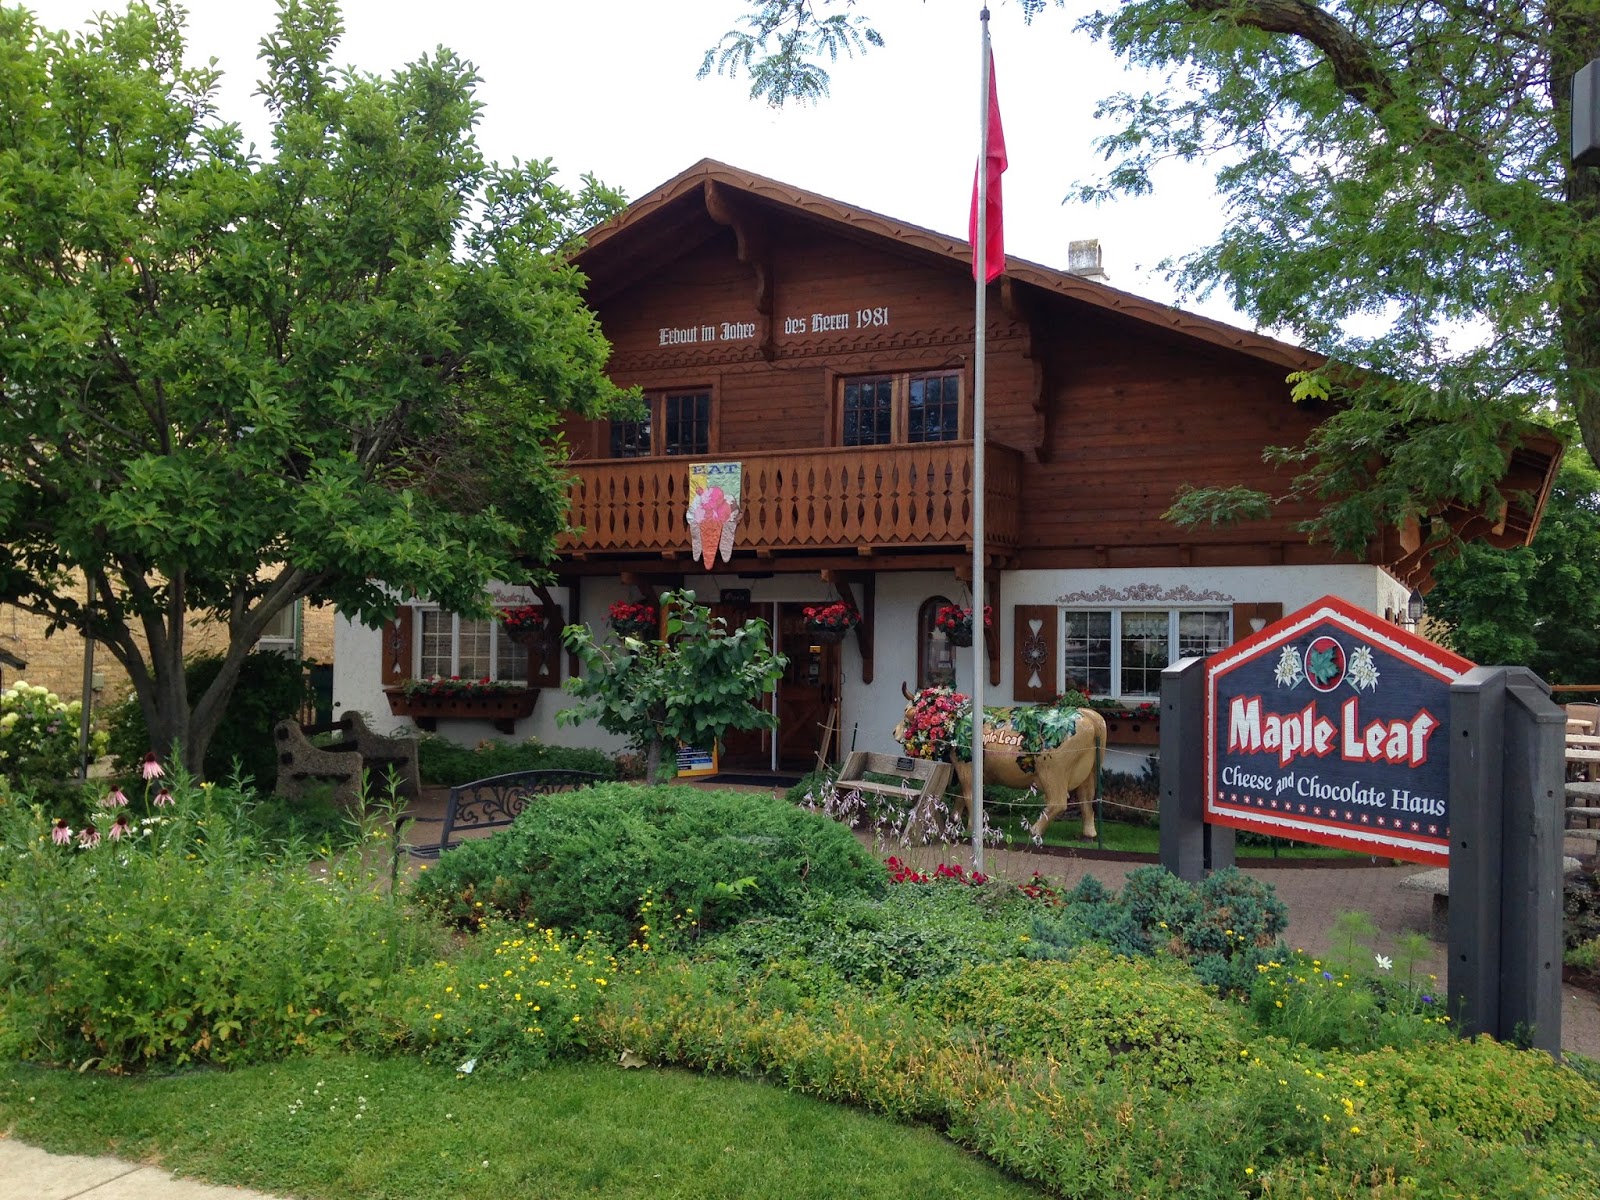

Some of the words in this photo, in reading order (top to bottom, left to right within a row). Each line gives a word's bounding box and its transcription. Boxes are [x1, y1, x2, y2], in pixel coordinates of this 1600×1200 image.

[701, 324, 716, 342] im
[784, 316, 807, 335] des
[811, 313, 850, 333] Herrn
[856, 306, 889, 329] 1981
[693, 464, 738, 475] EAT
[998, 730, 1025, 747] Leaf
[1228, 695, 1338, 768] Maple
[1341, 696, 1441, 768] Leaf
[1221, 765, 1273, 791] Cheese
[1276, 771, 1295, 796] and
[1296, 775, 1387, 808] Chocolate
[1390, 789, 1446, 817] Haus
